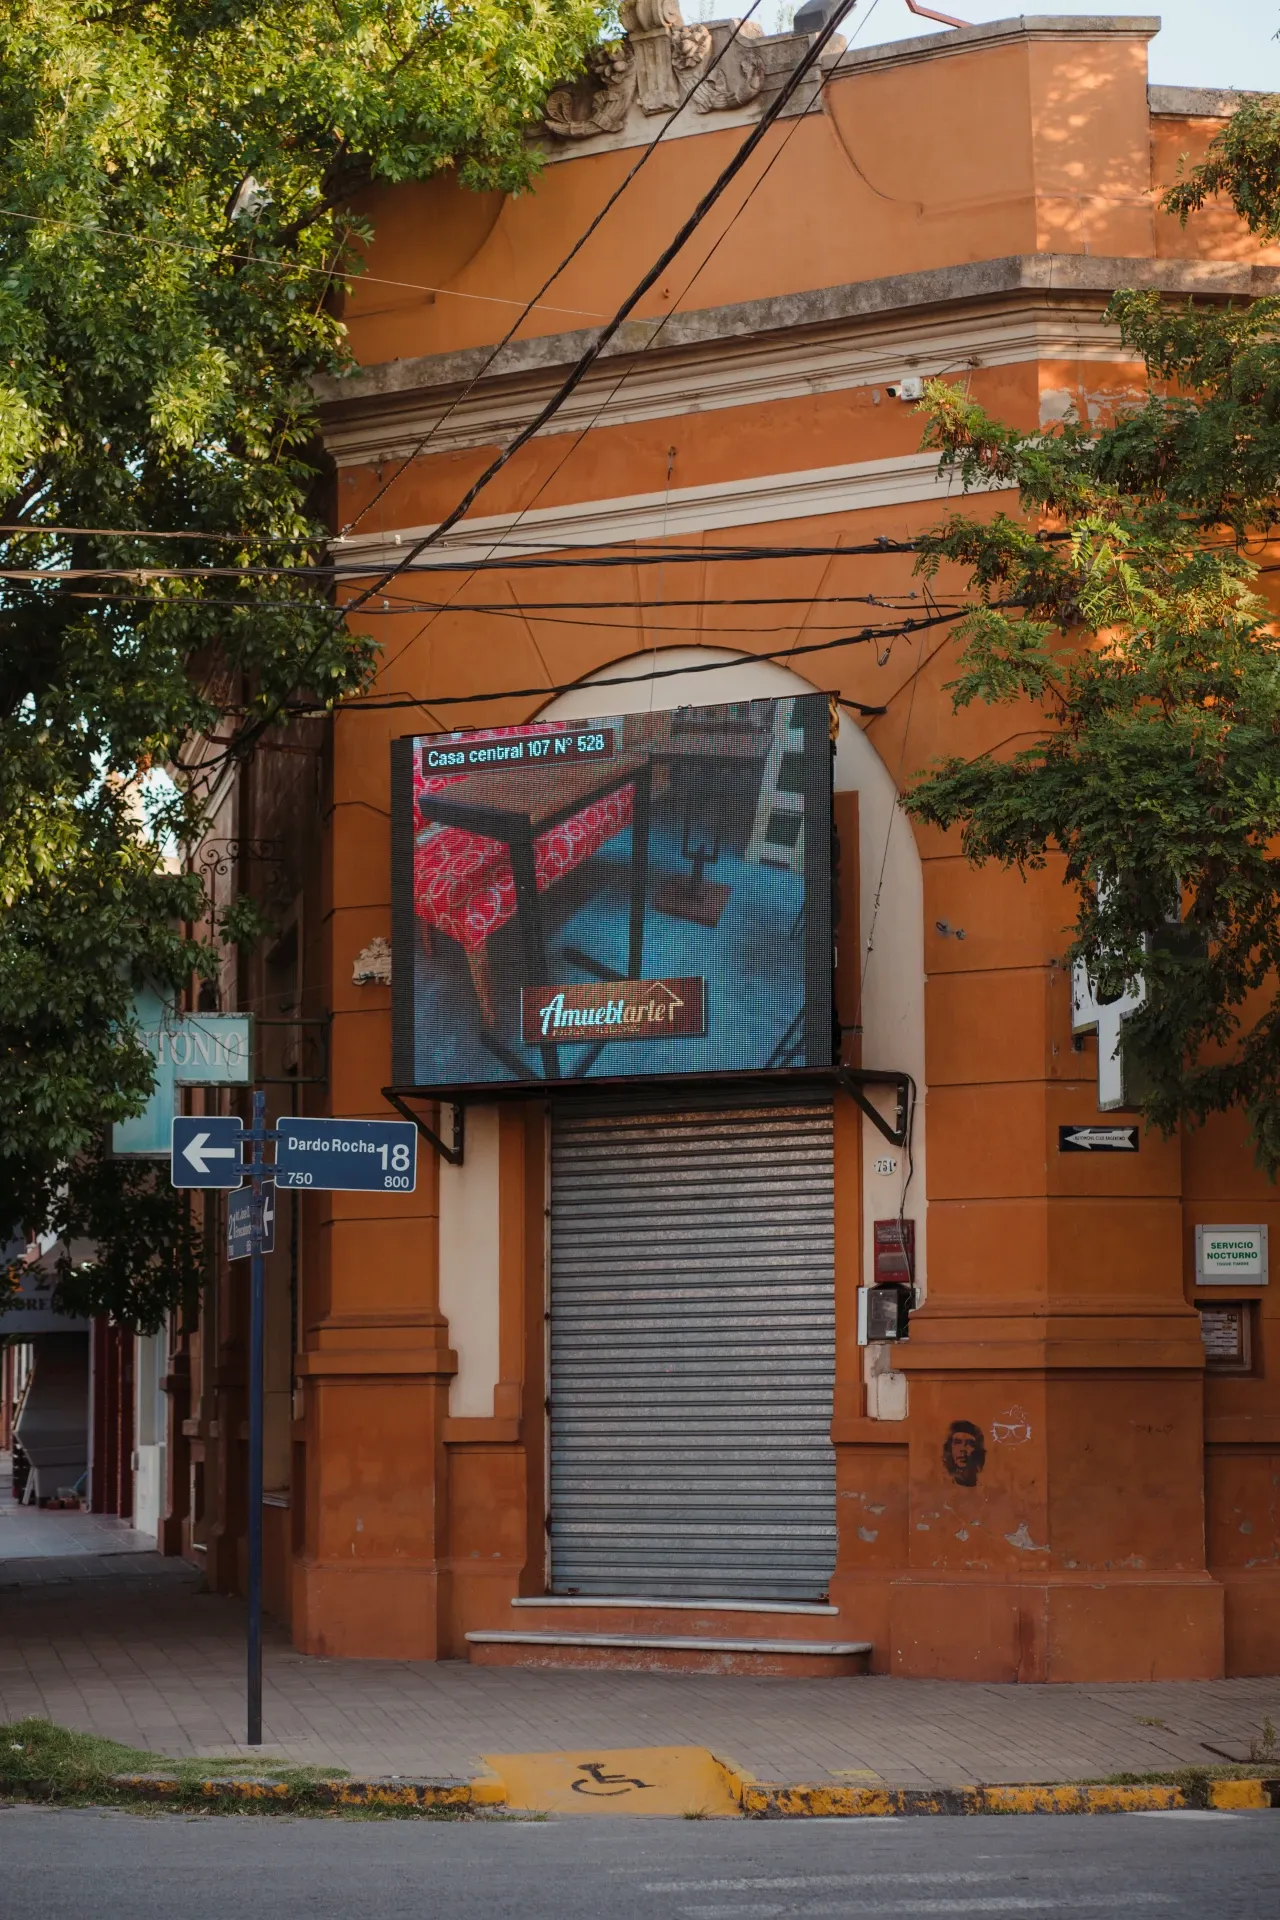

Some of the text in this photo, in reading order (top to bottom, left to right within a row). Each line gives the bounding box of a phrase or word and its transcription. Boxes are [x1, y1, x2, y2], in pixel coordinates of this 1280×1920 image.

[428, 750, 465, 767] Casa
[469, 742, 524, 763] central
[527, 739, 550, 757] 107
[577, 734, 605, 752] 528
[288, 1137, 375, 1153] Dardo Rocha
[376, 1143, 410, 1172] 18
[287, 1172, 313, 1185] 750
[384, 1175, 410, 1188] 800
[1210, 1241, 1254, 1250] SERVICIO
[1206, 1251, 1258, 1260] NOCTURNO
